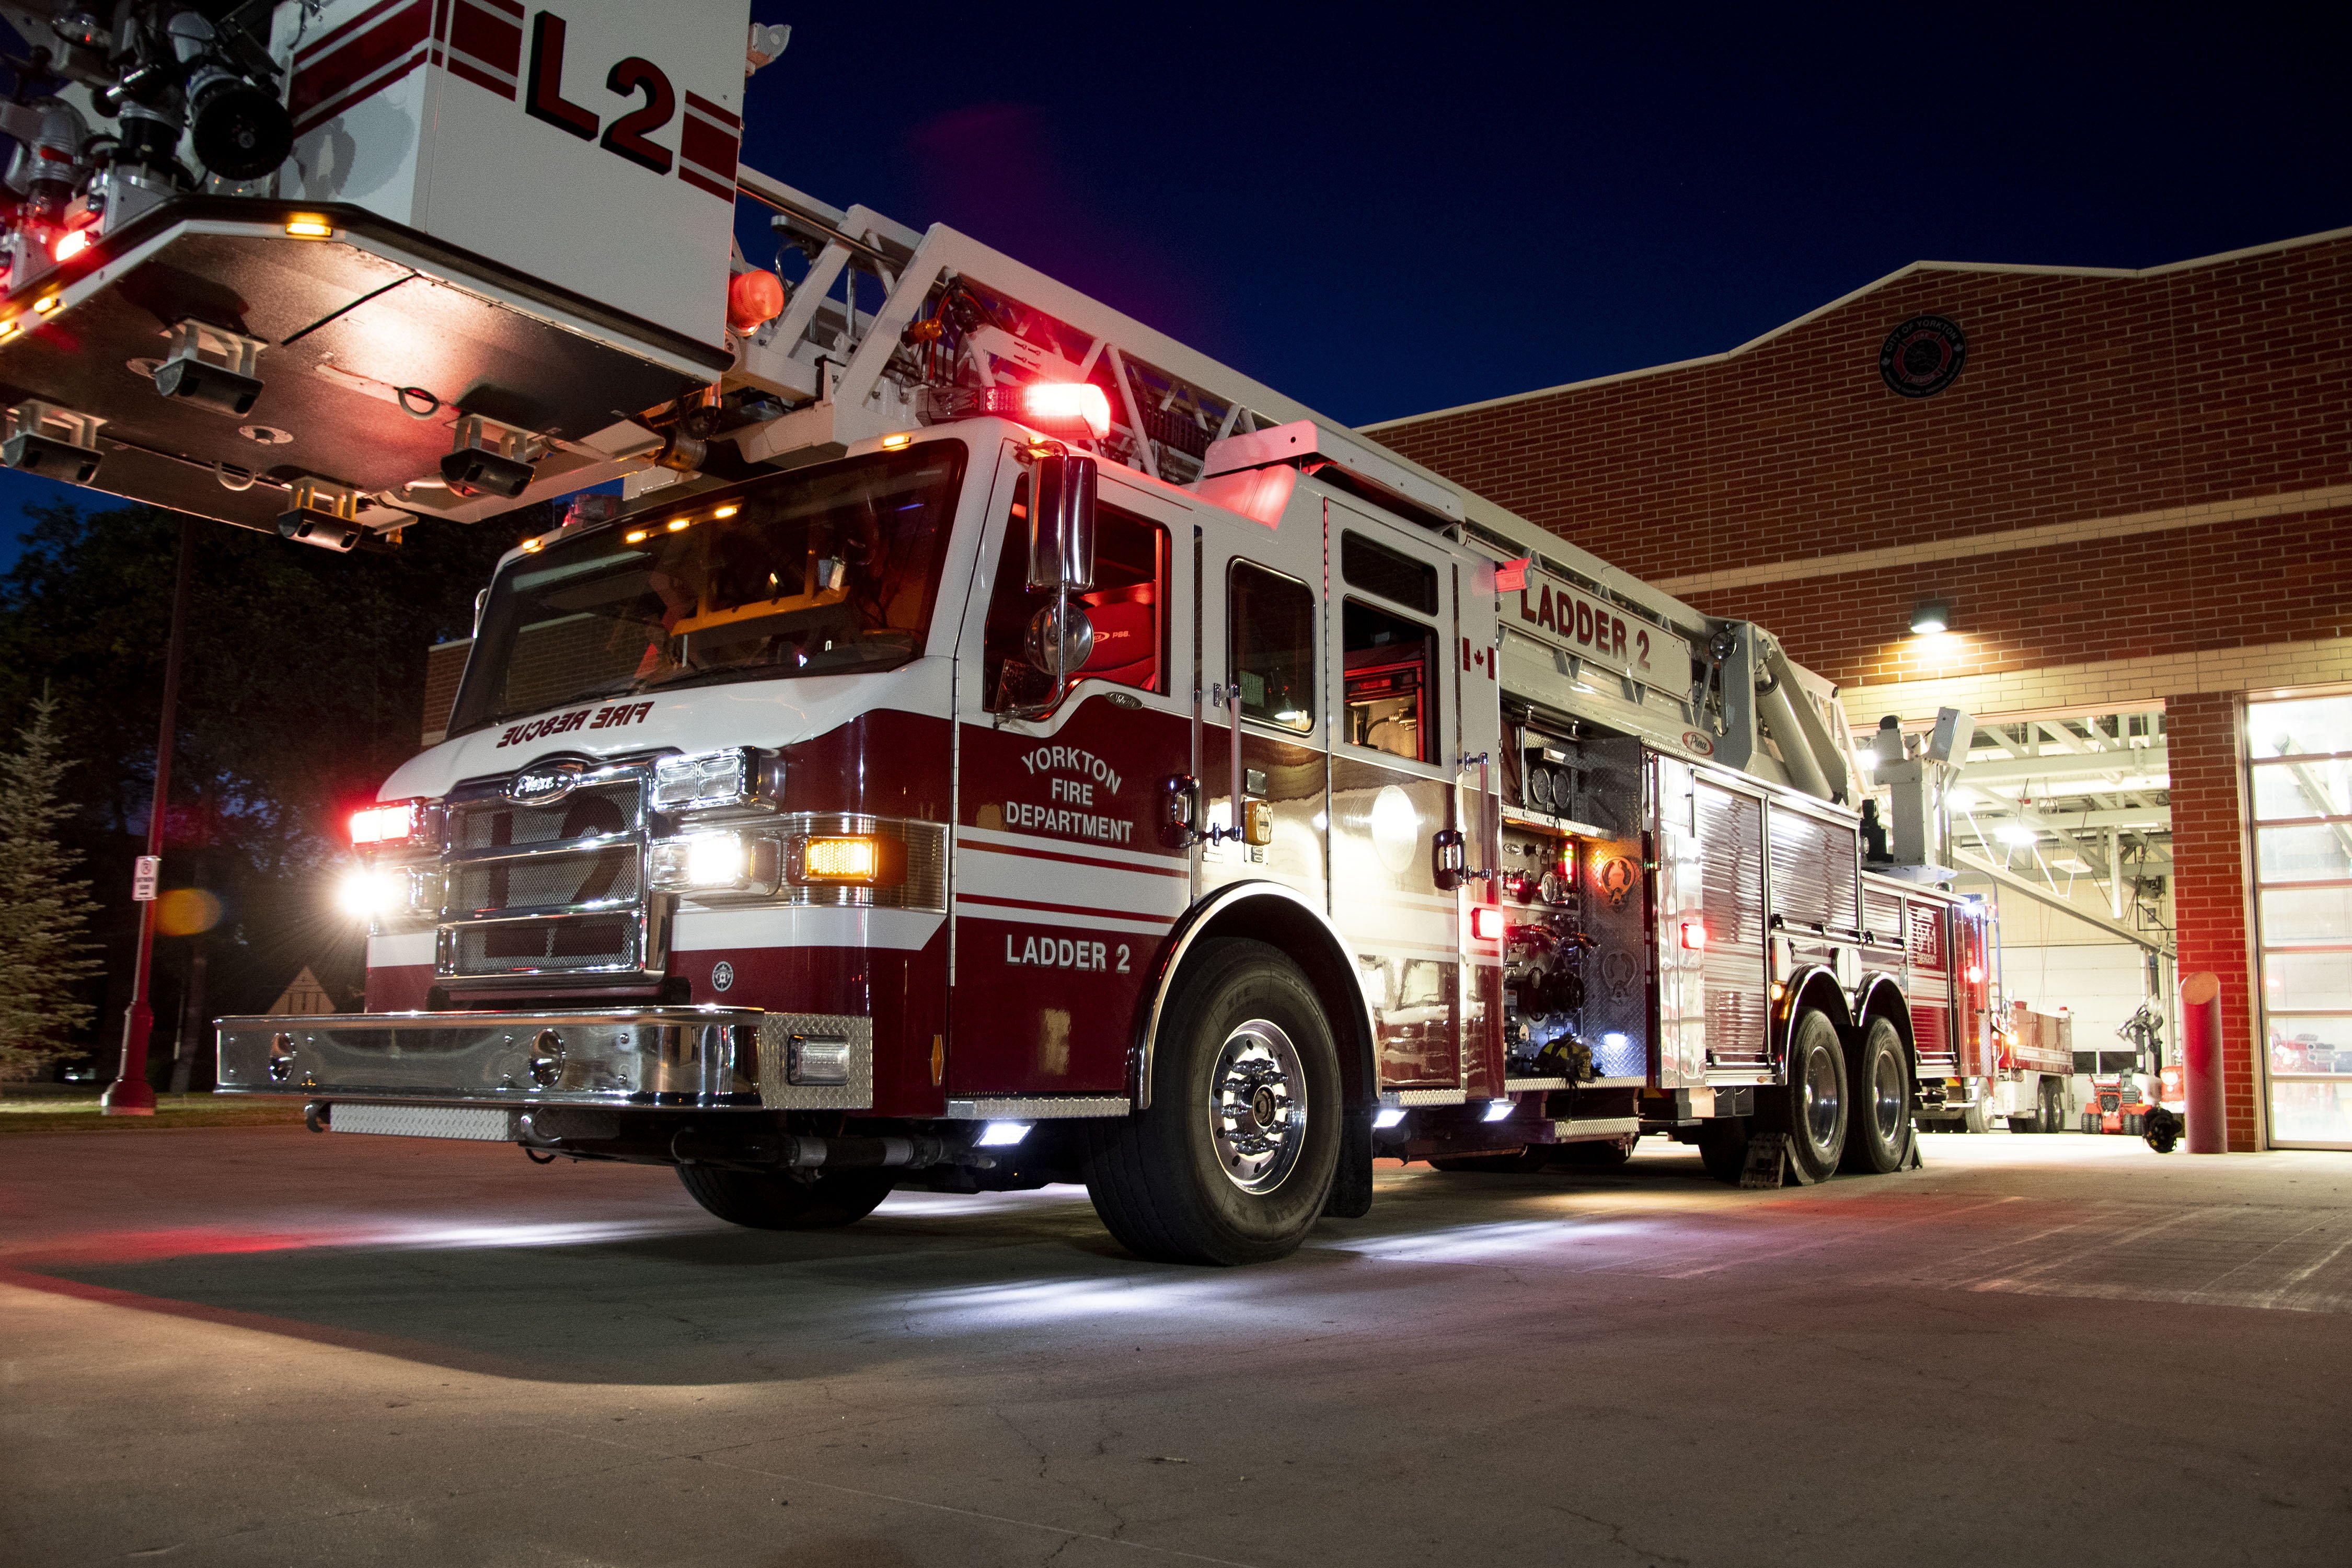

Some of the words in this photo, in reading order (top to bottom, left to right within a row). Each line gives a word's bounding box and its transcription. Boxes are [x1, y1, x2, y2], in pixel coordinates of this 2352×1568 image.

[526, 10, 676, 176] L2
[1885, 332, 1901, 352] CITY
[1901, 323, 1914, 334] OF
[1916, 319, 1958, 341] YORKTON
[1520, 583, 1627, 663] LADDER
[1636, 629, 1651, 673] 2
[1690, 734, 1708, 751] Pierce
[1021, 746, 1122, 795] YORKTON
[1051, 778, 1093, 807] FIRE
[1006, 801, 1133, 843] DEPARTMENT
[1006, 934, 1106, 972] LADDER
[1116, 943, 1131, 974] 2
